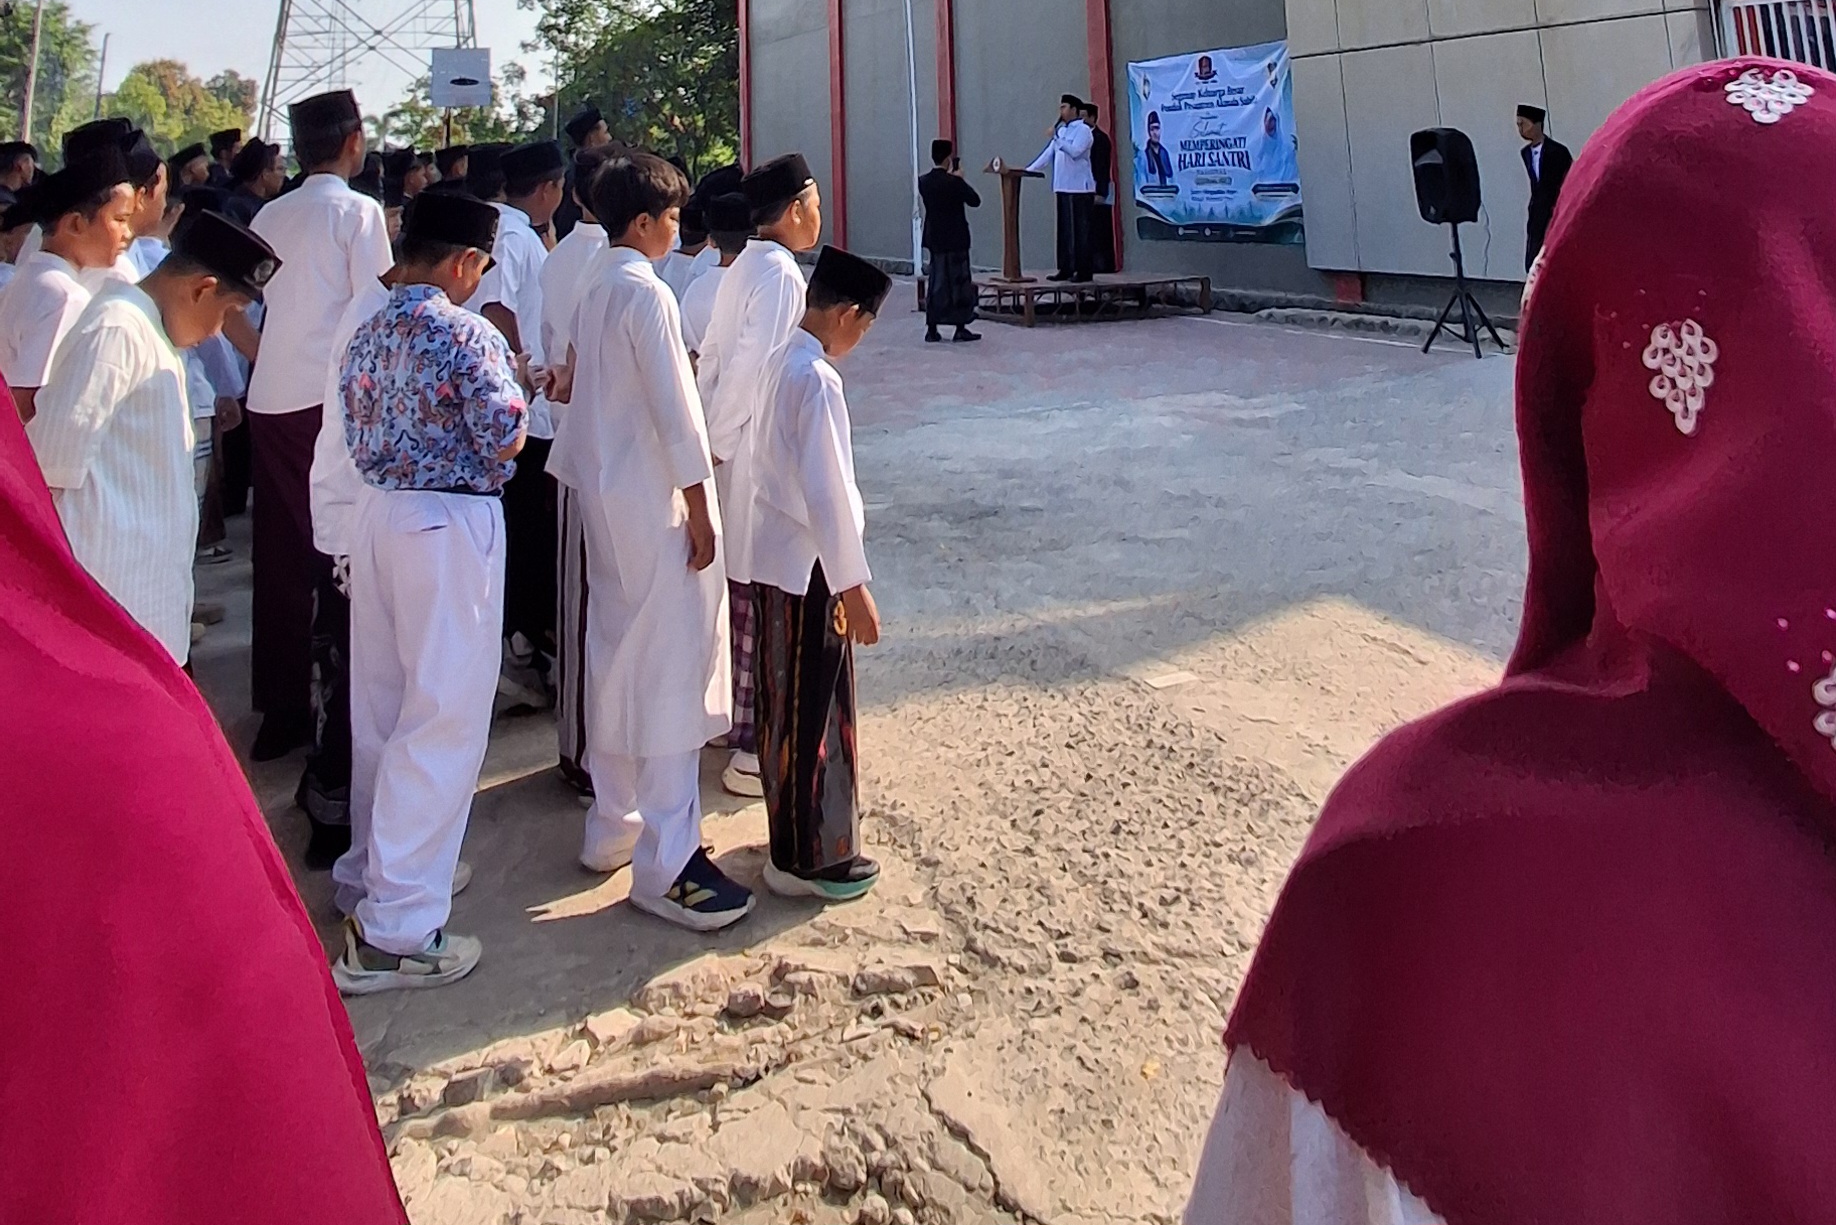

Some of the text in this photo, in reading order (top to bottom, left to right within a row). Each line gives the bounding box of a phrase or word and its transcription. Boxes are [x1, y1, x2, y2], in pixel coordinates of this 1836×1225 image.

[1180, 137, 1247, 151] MEMPERINGATI
[1178, 150, 1251, 171] HARI SANTRI
